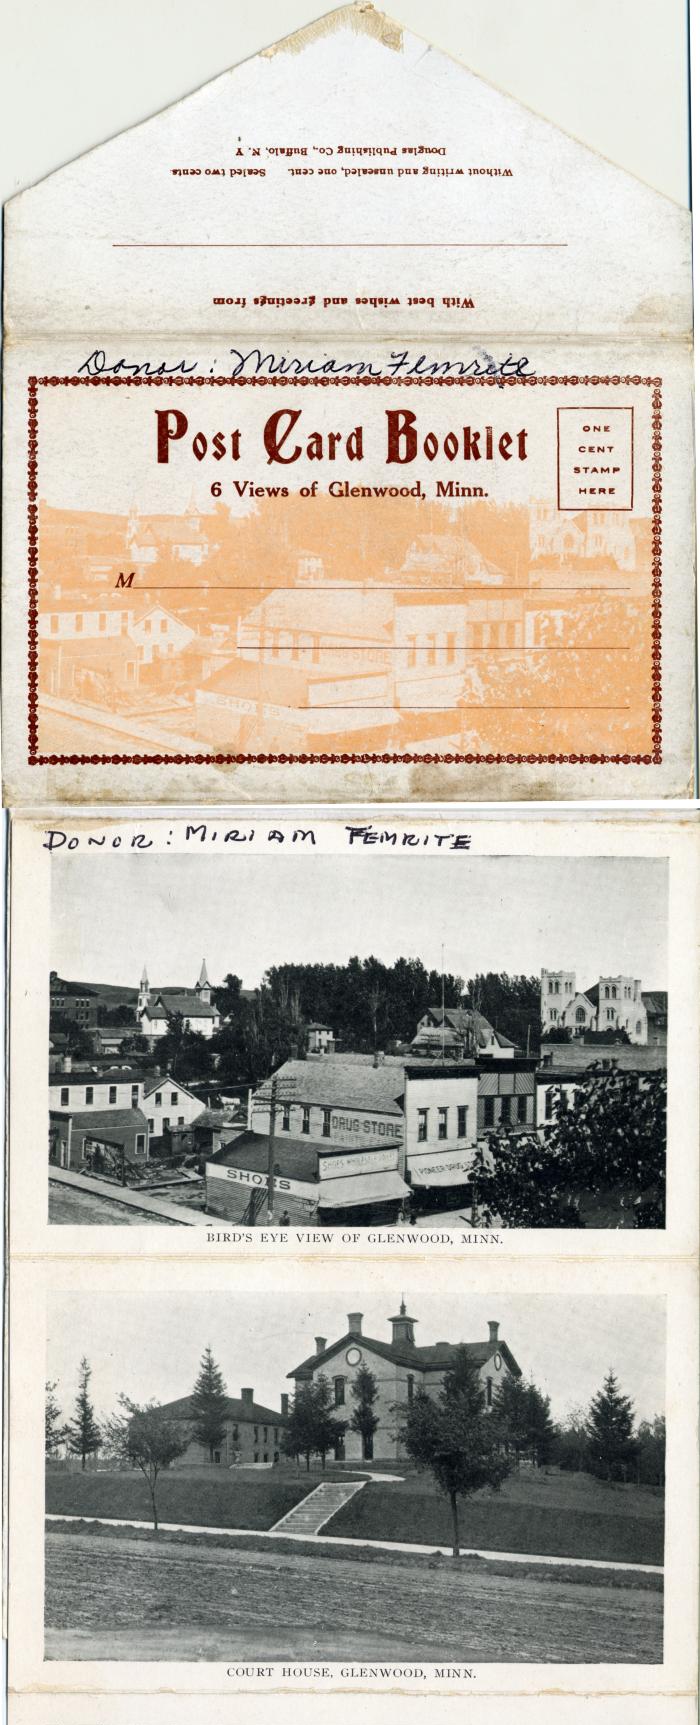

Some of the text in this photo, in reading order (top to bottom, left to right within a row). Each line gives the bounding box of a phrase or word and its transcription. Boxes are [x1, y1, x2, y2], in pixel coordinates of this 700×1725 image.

[265, 146, 308, 158] Buffalo,
[337, 146, 397, 157] Publishing
[402, 146, 446, 157] Douglas
[204, 168, 226, 177] two
[229, 168, 266, 178] Sealed
[287, 165, 514, 178] Without writing and unsealed, one cent.
[212, 295, 476, 309] With best wishes and greetings from
[230, 349, 382, 377] Miriam
[582, 425, 611, 433] ONE
[154, 408, 529, 466] Post Card Booklet
[578, 445, 615, 454] CENT
[573, 466, 621, 474] STAMP
[210, 480, 489, 501] 6 Views of Glenwood, Minn.
[578, 487, 616, 495] HERE
[114, 572, 134, 589] M
[185, 824, 317, 846] MIRIAM
[344, 824, 472, 851] FEMRITE
[362, 1119, 404, 1139] STORE
[207, 1232, 504, 1245] BIRD'S EYE VIEW OF GLENWOOD, MINN.
[226, 1667, 477, 1680] COURT HOUSE, GLENWOOD, MINN.
